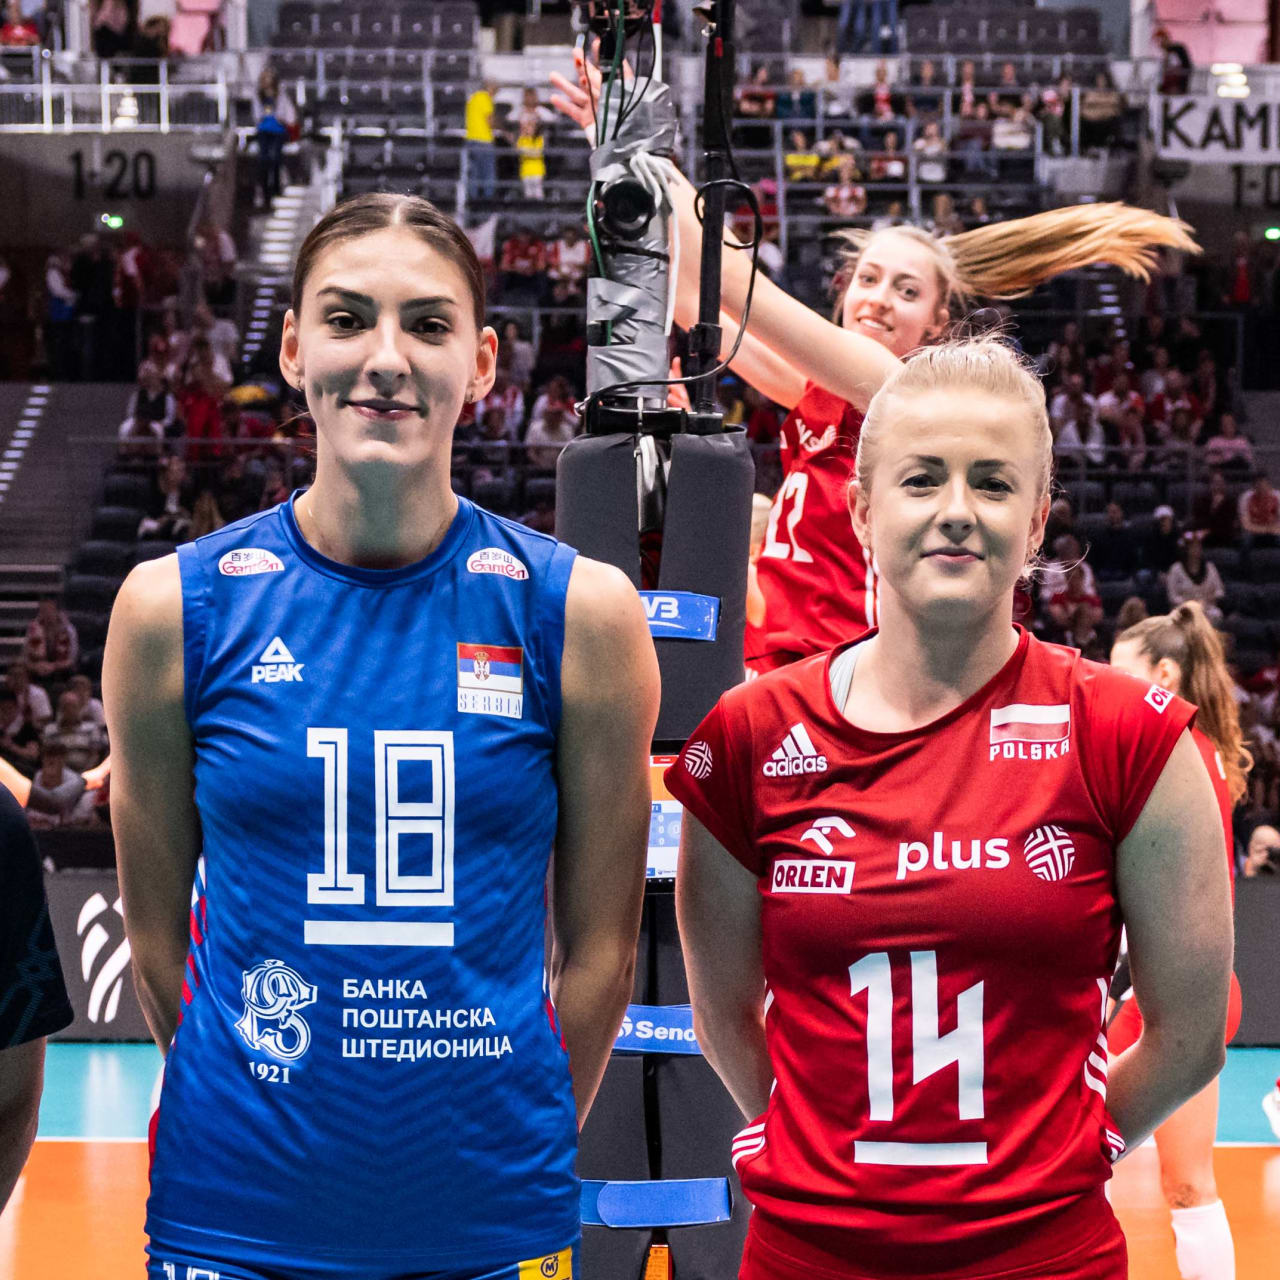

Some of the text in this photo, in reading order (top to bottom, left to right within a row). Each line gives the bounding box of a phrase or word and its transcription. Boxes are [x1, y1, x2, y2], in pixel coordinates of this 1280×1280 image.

[69, 149, 156, 200] 1-20
[641, 596, 679, 618] VB
[251, 663, 304, 683] PEAK
[460, 692, 522, 717] SERBIA
[989, 739, 1071, 761] POLSKA
[763, 752, 827, 777] adidas
[307, 727, 455, 906] 18
[896, 832, 1010, 880] plus
[775, 864, 846, 888] ORLEN
[342, 978, 428, 999] БАНКА
[342, 1007, 496, 1028] ПОШТАНСКА
[635, 1020, 697, 1042] Seno
[848, 950, 984, 1122] 14
[342, 1036, 513, 1061] ШТЕДИОНИЦА
[249, 1062, 291, 1084] 1921
